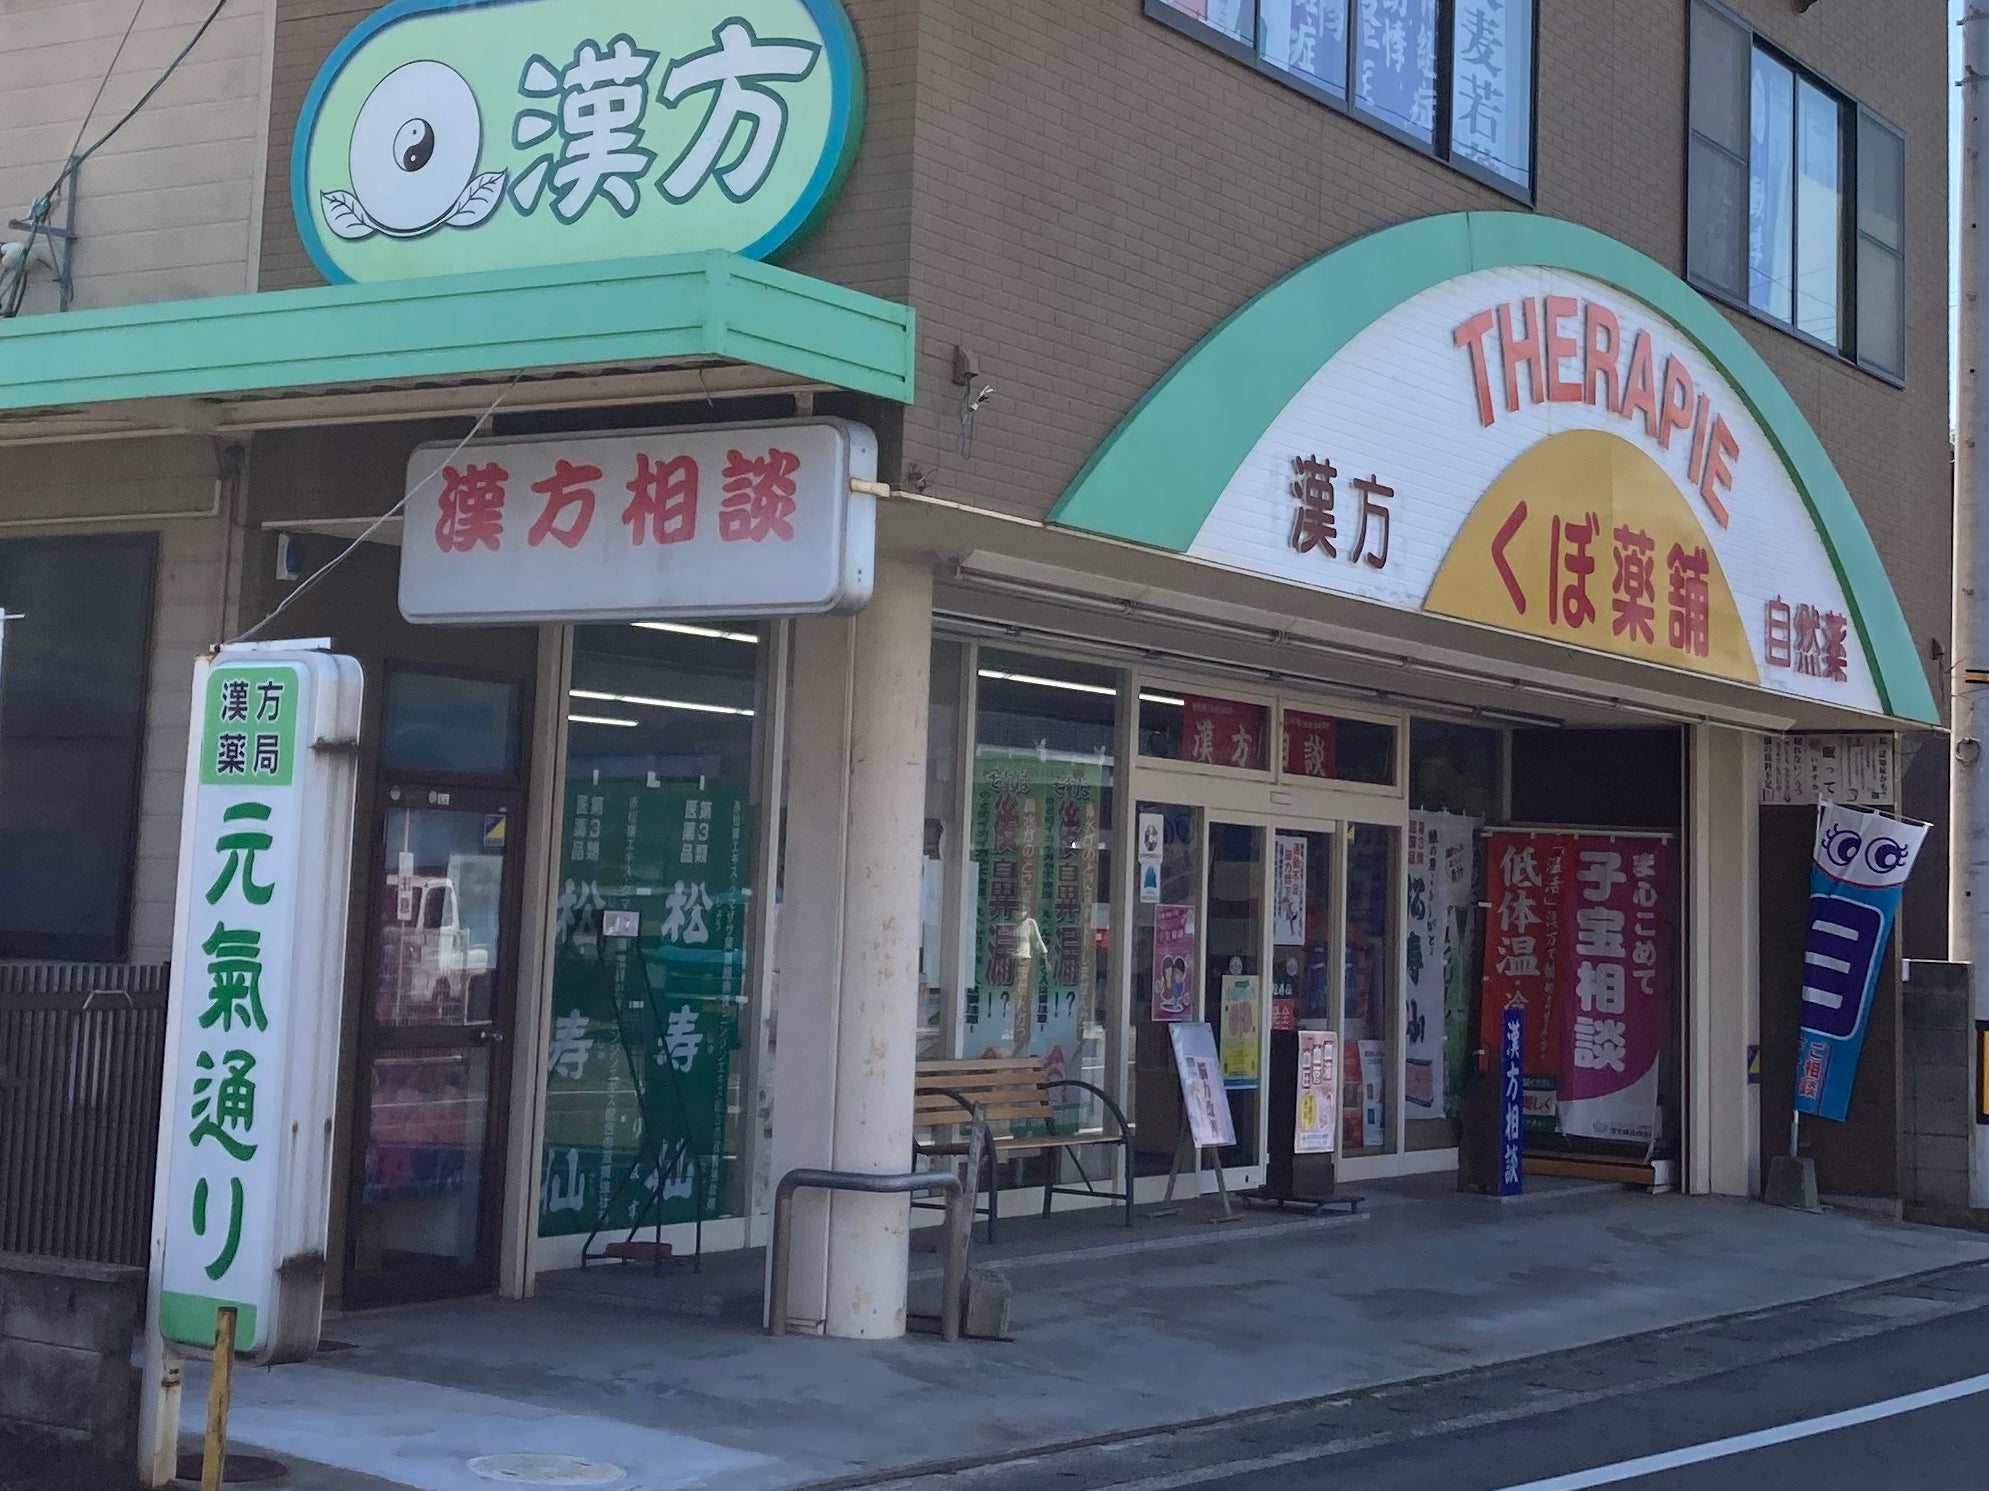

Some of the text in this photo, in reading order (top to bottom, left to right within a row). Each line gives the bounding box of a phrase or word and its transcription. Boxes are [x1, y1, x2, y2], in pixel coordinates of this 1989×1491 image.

[508, 17, 822, 224] 漢方
[1458, 0, 1504, 174] 麦若
[1453, 295, 1741, 530] THERAPIE
[434, 448, 800, 553] 漢方相談
[1289, 453, 1395, 570] 漢方
[1491, 500, 1711, 659] くぼ薬舗
[221, 681, 283, 721] 漢方
[1765, 594, 1848, 683] 自然薬
[217, 733, 279, 774] 薬局
[189, 802, 276, 1280] 元氣通り
[1573, 851, 1627, 1074] 子宝相談
[1504, 1019, 1521, 1186] 漢方相談
